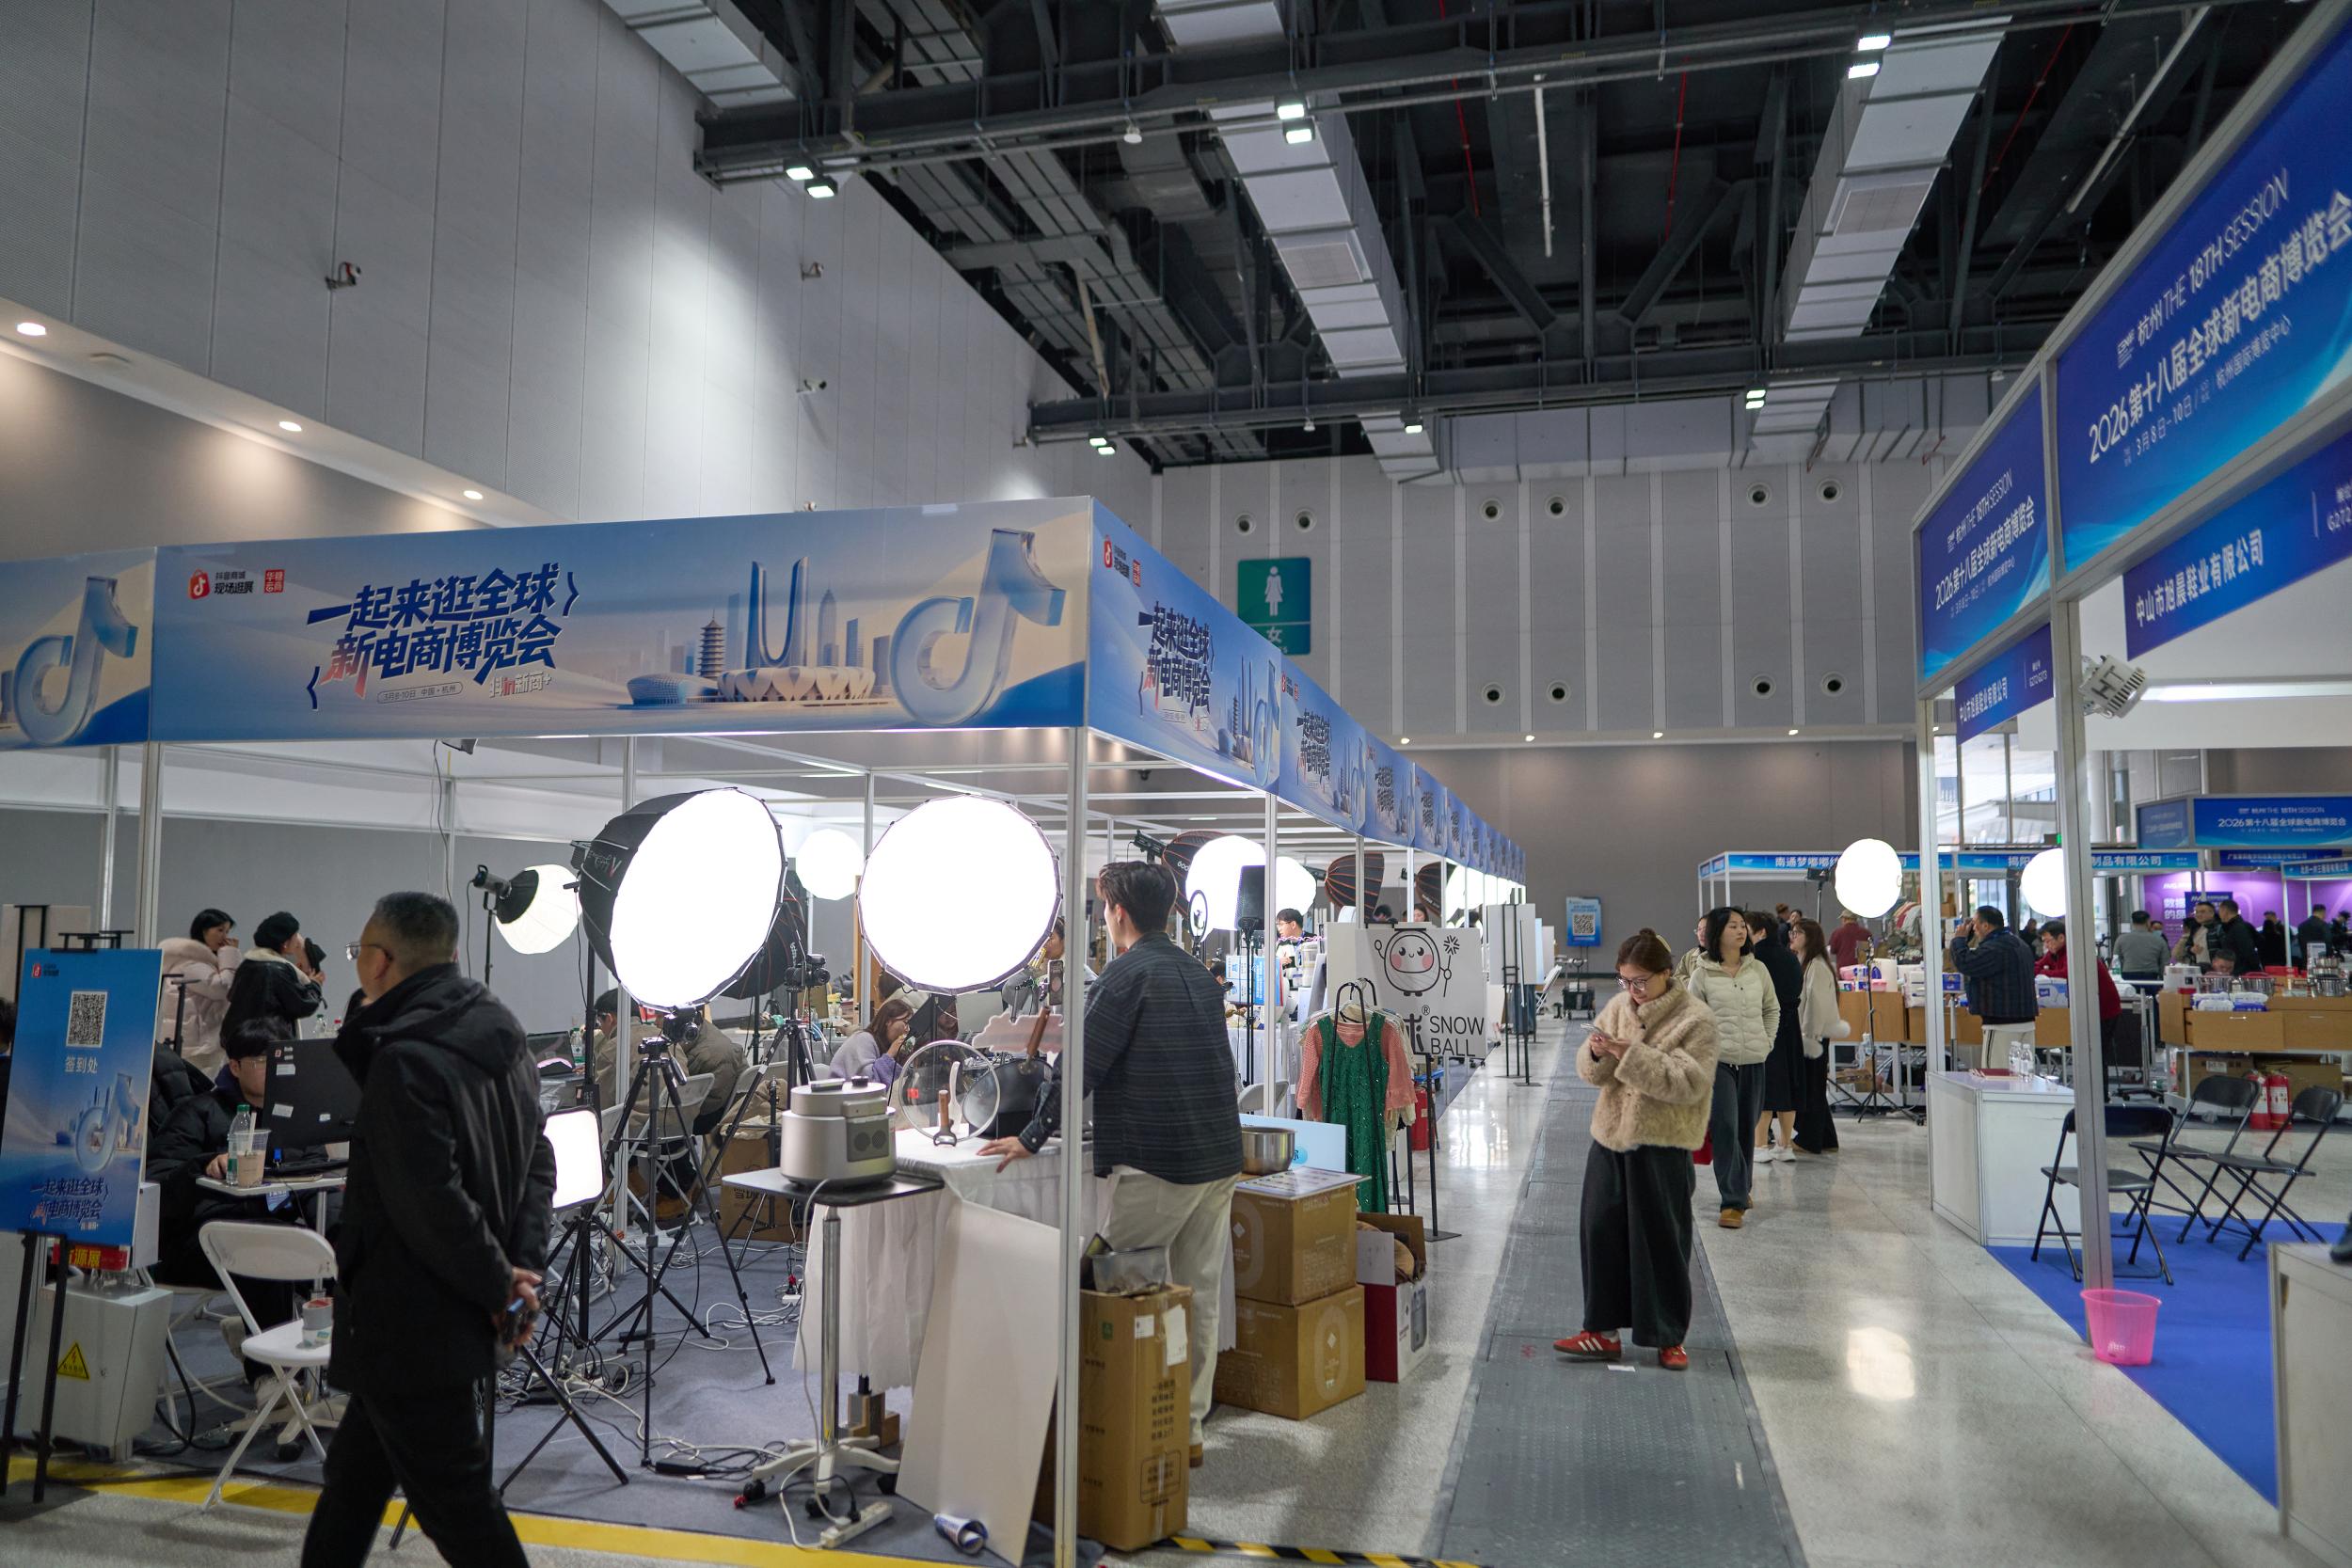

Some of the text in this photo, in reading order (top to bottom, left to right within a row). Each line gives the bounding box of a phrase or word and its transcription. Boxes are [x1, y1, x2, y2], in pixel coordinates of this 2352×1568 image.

[2164, 275, 2186, 320] THE
[2189, 236, 2223, 293] 18TH
[2224, 166, 2290, 259] SESSION
[2090, 190, 2352, 463] 2026第十八届全球新电商博览会
[307, 562, 560, 633] 一起来逛全球
[318, 613, 563, 699] 新电商博览会
[1138, 600, 1210, 664] 一起来逛全球
[1266, 626, 1283, 644] 女
[1143, 644, 1212, 718] 新电商博览会
[1429, 1015, 1485, 1036] SNOW
[1430, 1038, 1475, 1056] BALL
[65, 1054, 98, 1073] 签到处
